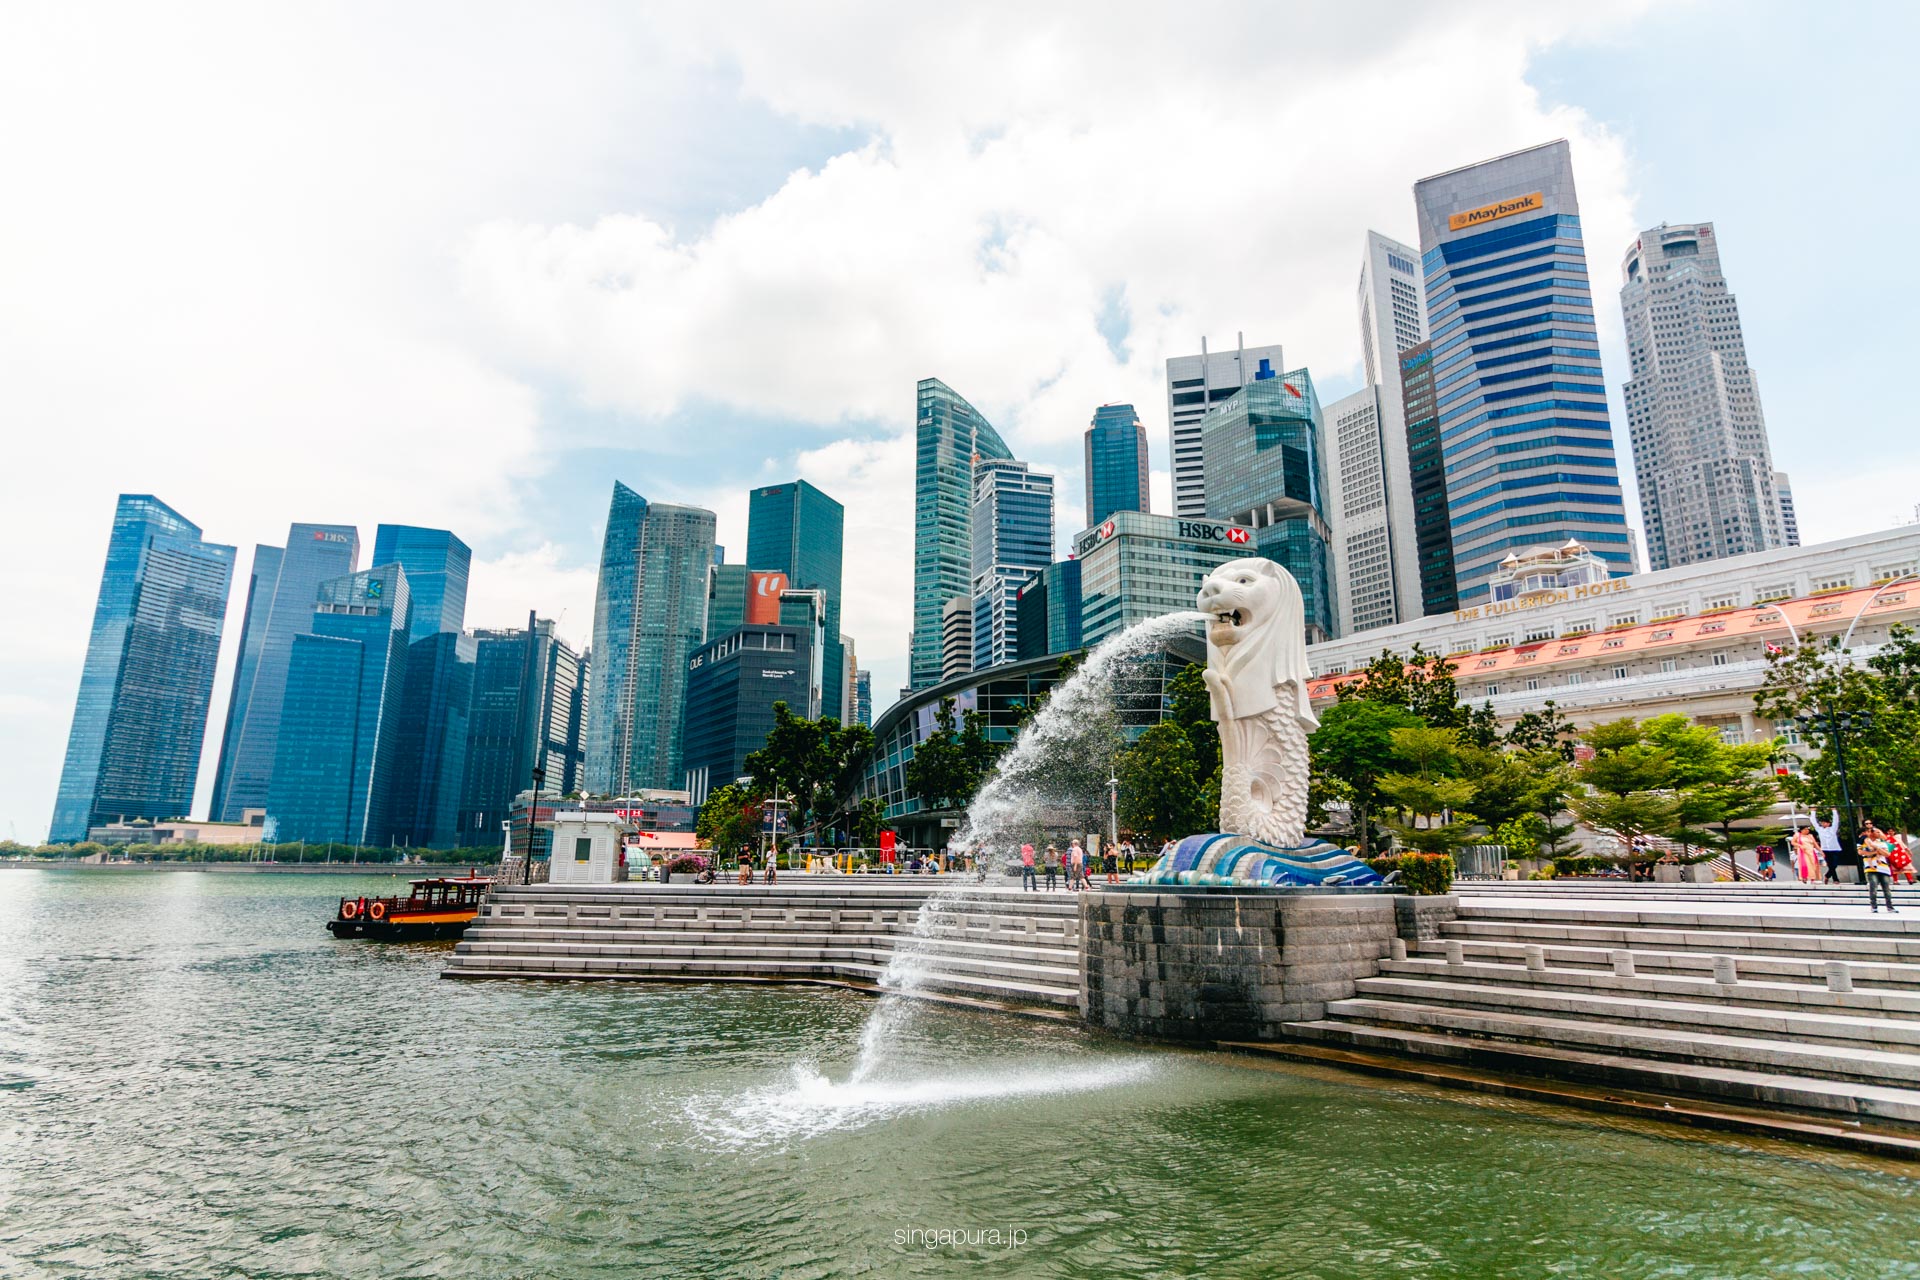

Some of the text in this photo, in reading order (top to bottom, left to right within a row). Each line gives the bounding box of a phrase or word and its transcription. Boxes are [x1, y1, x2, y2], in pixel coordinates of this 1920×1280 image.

[1468, 197, 1534, 222] Maybank
[1220, 400, 1239, 415] MYP
[324, 532, 347, 542] DBS
[1079, 528, 1102, 555] HSBC
[1178, 521, 1224, 541] HSBC
[1453, 578, 1631, 622] THE FULLERTON HOTEL
